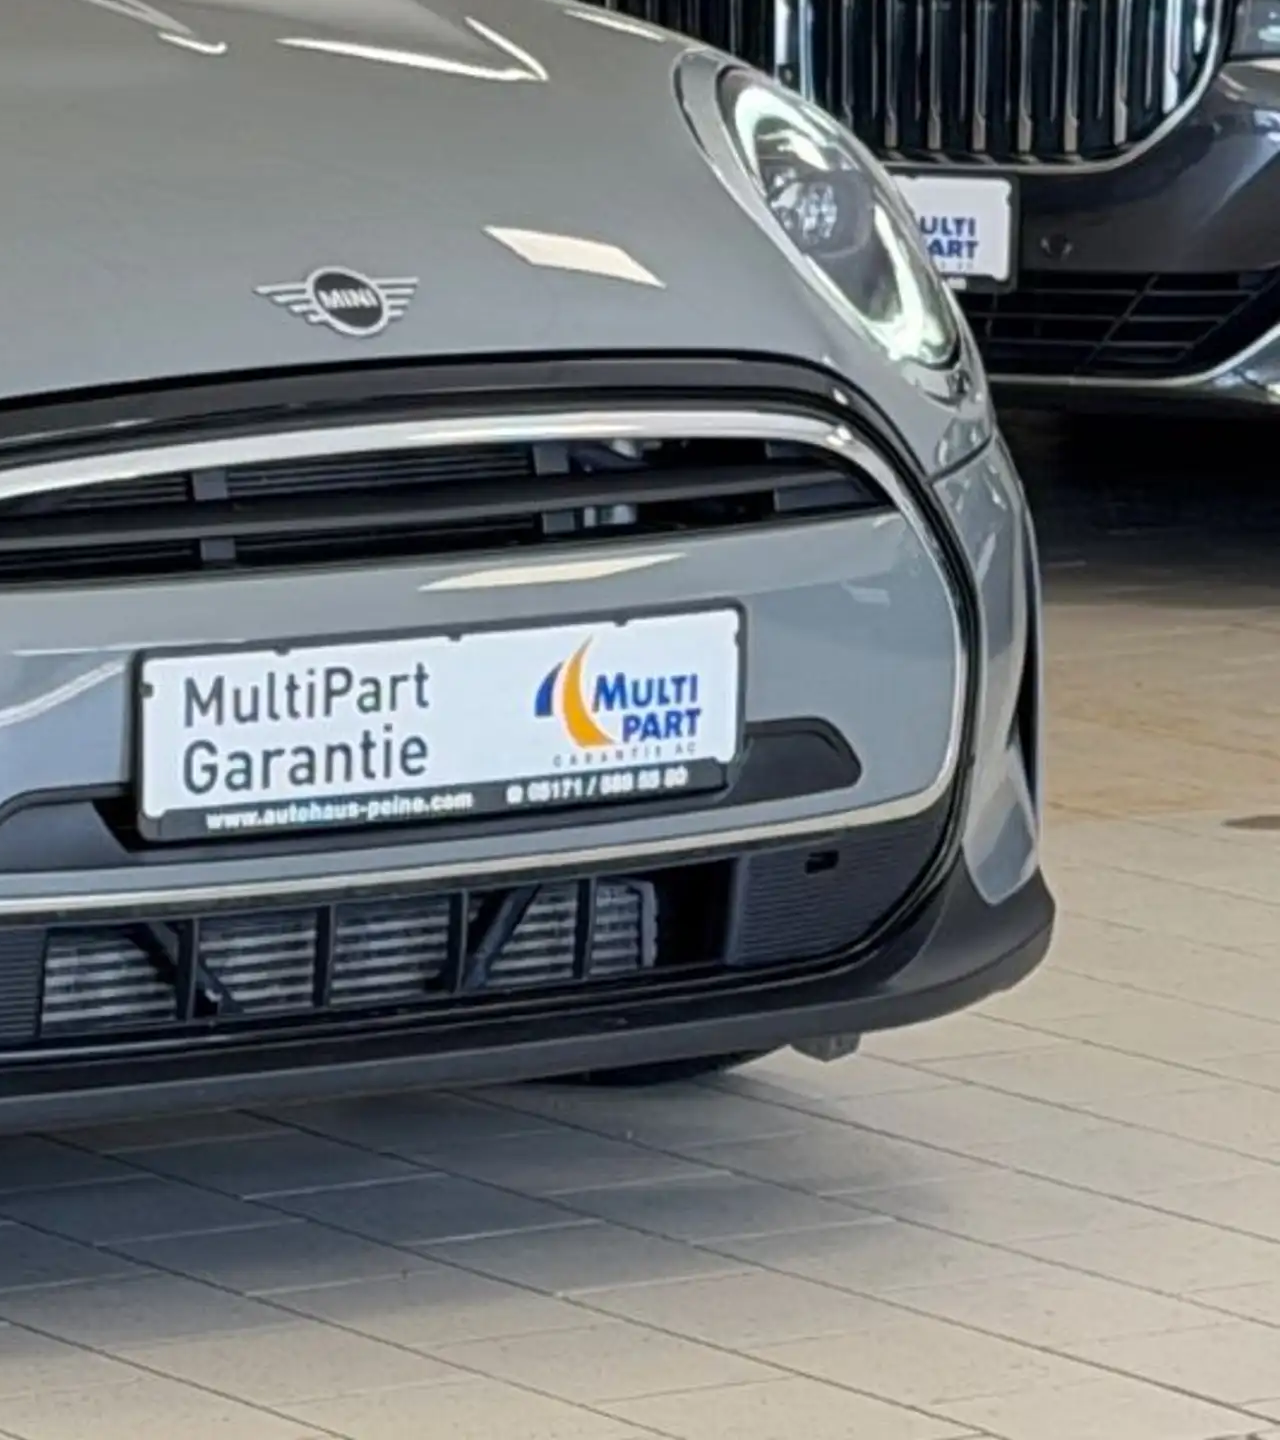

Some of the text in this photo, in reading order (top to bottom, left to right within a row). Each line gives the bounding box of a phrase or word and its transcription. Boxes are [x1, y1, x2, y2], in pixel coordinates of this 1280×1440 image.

[918, 215, 977, 237] ULTI
[926, 238, 980, 260] ART
[318, 288, 379, 309] MINI
[183, 663, 430, 727] MultiPart
[591, 673, 699, 712] MULTI
[621, 707, 702, 743] PART
[182, 725, 429, 795] Garantie
[205, 792, 474, 830] www.autohaus-peine.com
